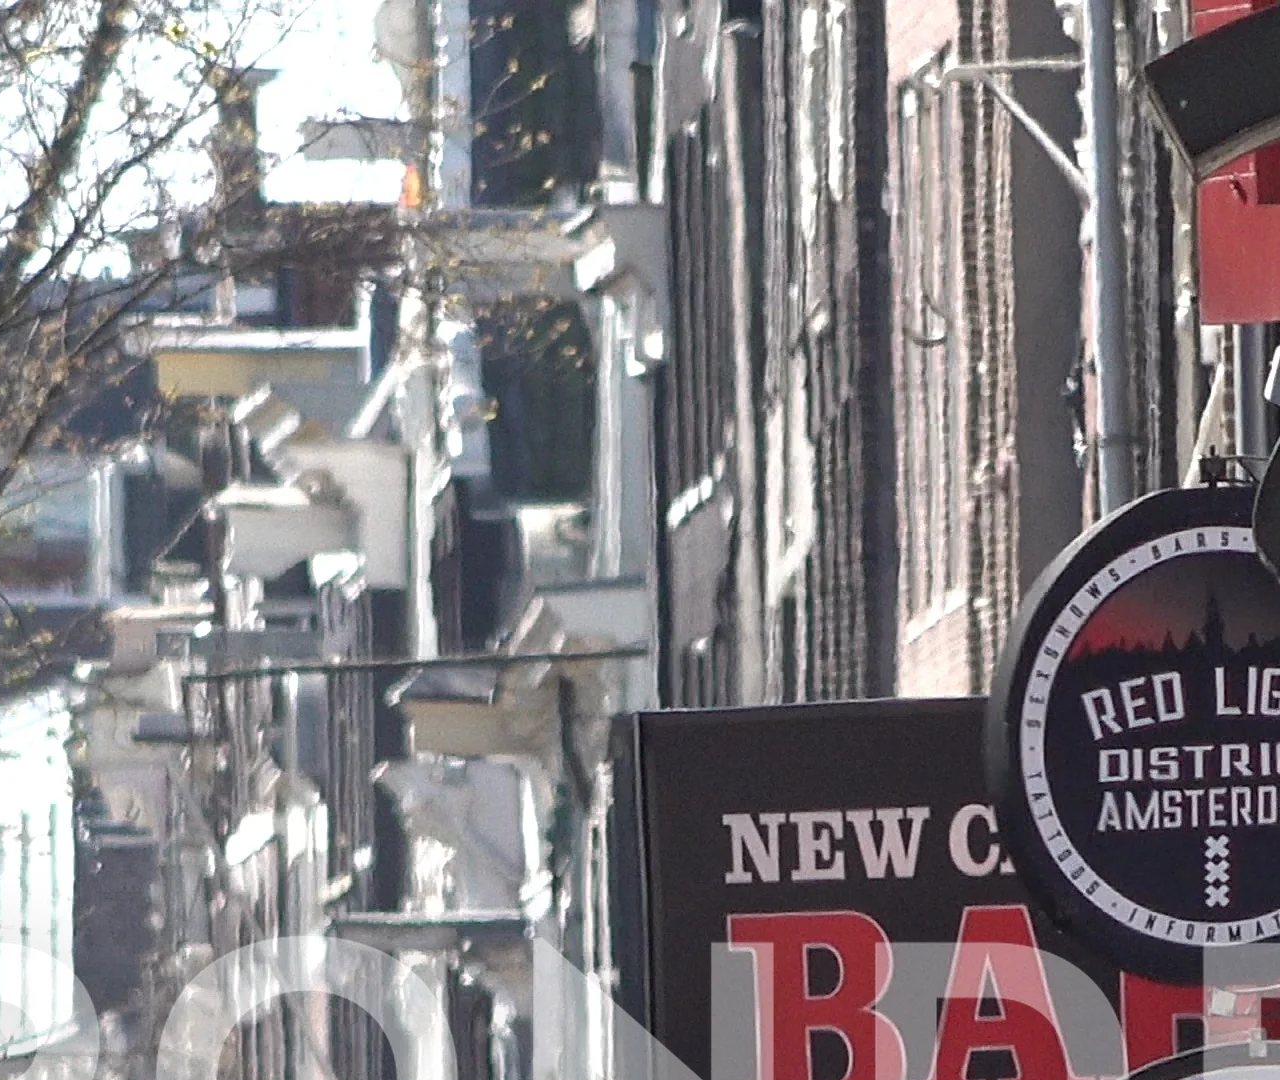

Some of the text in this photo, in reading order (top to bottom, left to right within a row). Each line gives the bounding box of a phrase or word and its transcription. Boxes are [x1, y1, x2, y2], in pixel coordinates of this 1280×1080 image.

[1151, 531, 1230, 561] BARS
[1081, 671, 1186, 740] RED
[722, 803, 1016, 884] NEW C
[1025, 770, 1097, 896] TATTOOS
